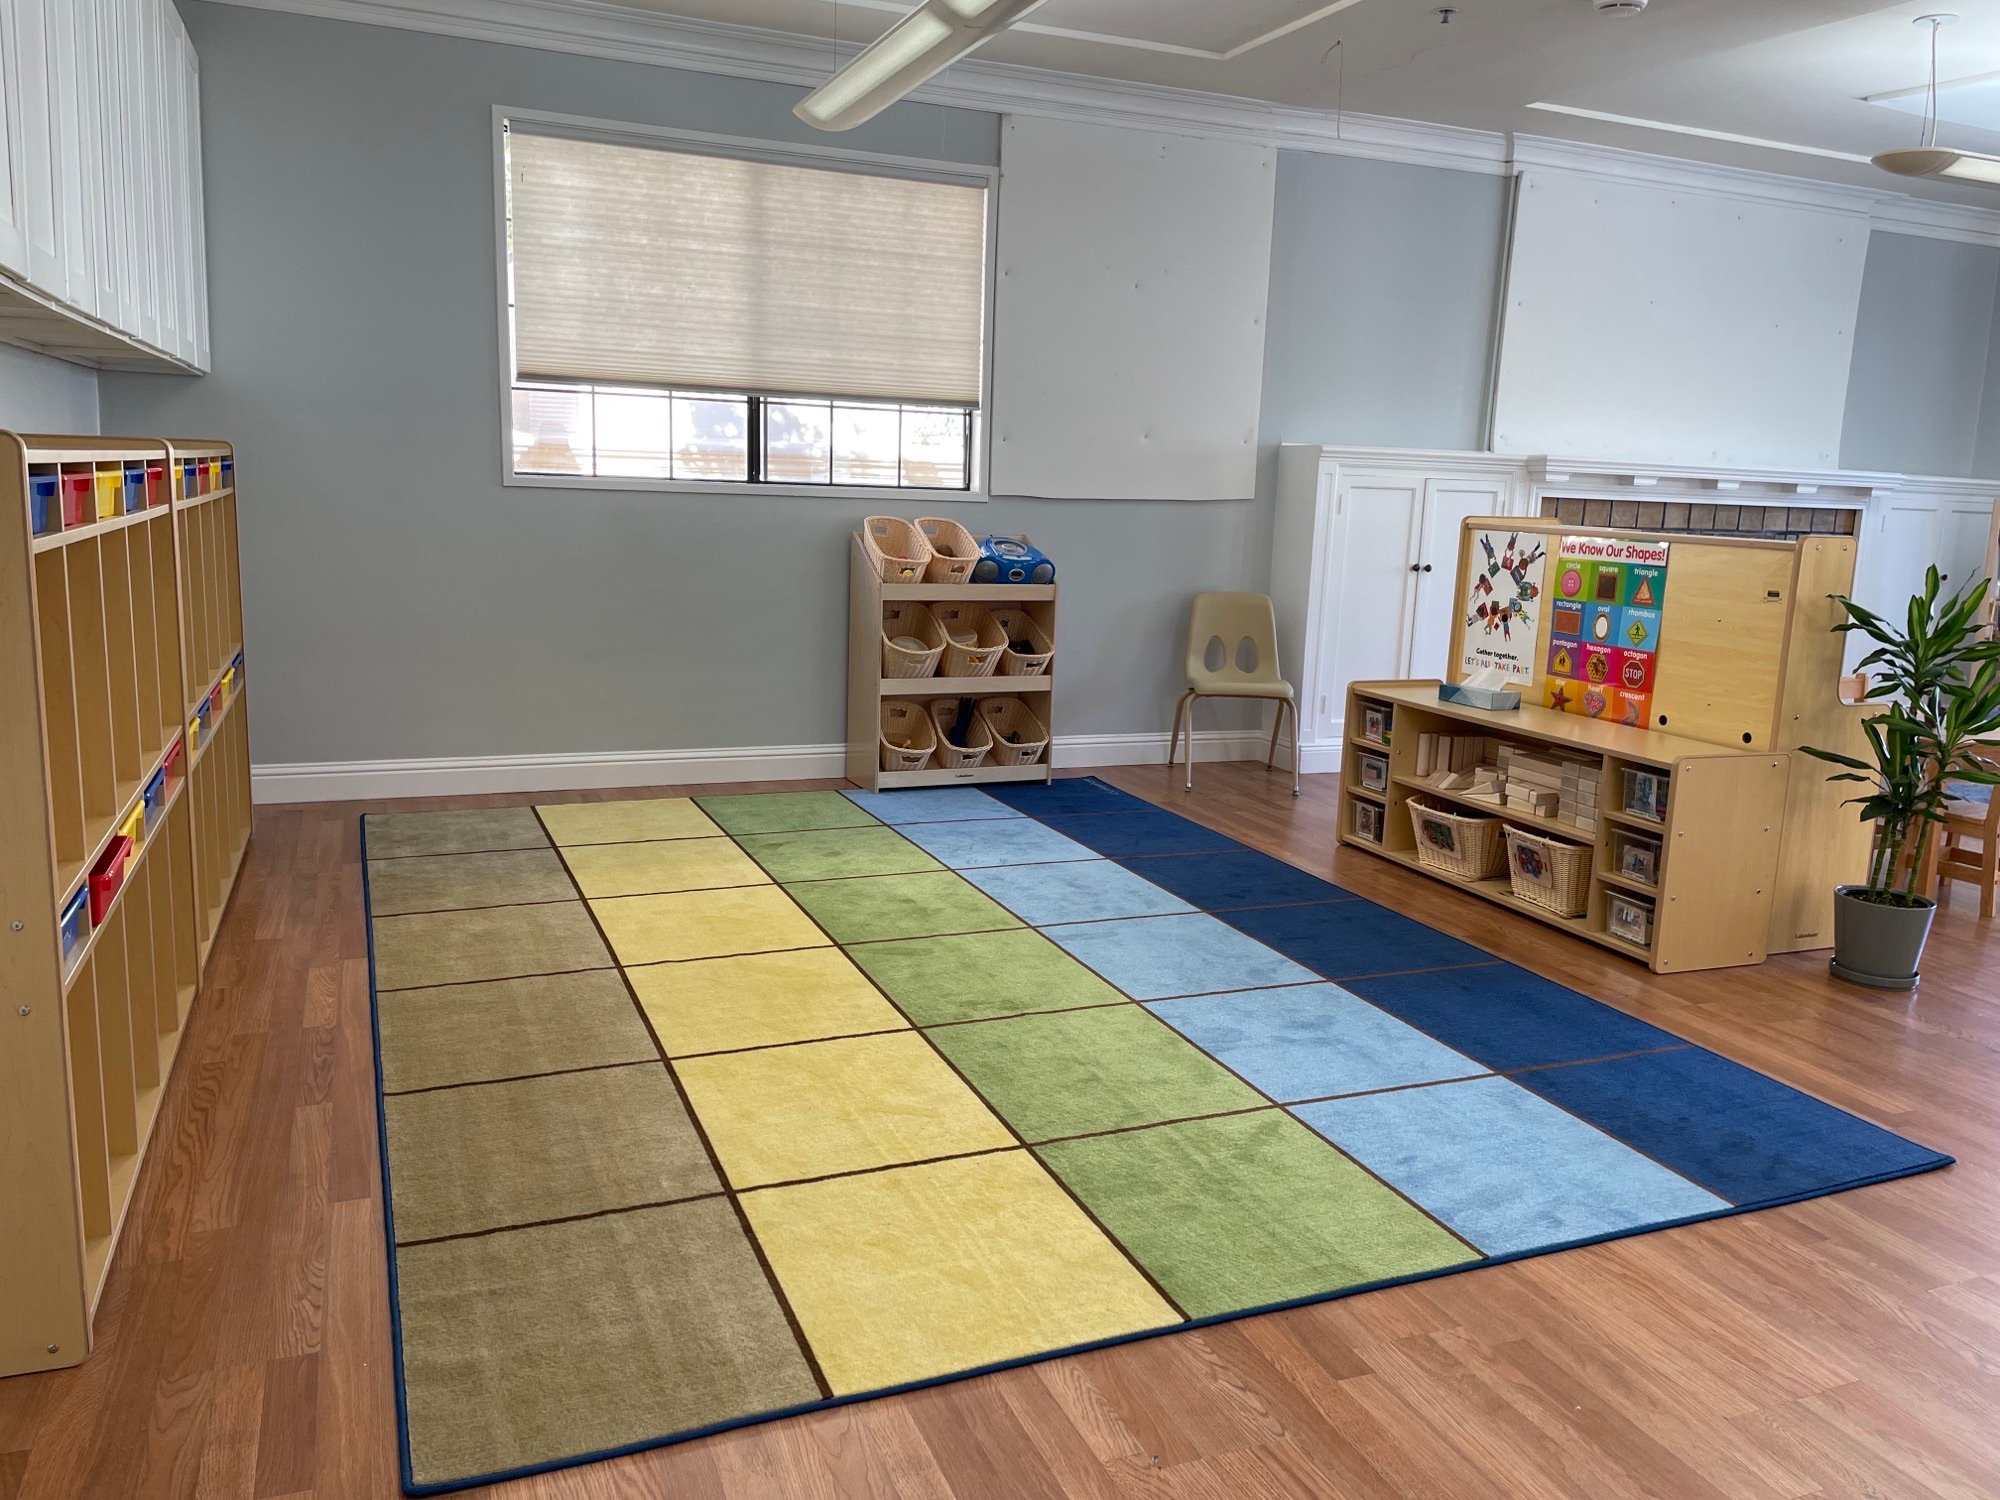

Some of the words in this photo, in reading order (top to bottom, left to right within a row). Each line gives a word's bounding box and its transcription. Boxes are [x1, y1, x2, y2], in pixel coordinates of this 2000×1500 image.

[1562, 541, 1576, 554] We
[1579, 543, 1604, 556] Know
[1606, 544, 1624, 558] Our
[1625, 546, 1665, 563] Shapes!
[1565, 562, 1581, 570] circle
[1599, 565, 1619, 573] square
[1634, 567, 1659, 577] triangle
[1556, 600, 1581, 610] rectangle
[1597, 605, 1610, 613] oval
[1627, 609, 1656, 619] rhombus
[1552, 638, 1578, 649] pentagon
[1586, 643, 1612, 655] hexagon
[1623, 650, 1648, 660] octagon
[1465, 657, 1479, 666] LET'S
[1495, 662, 1510, 672] TAKE
[1625, 667, 1643, 679] STOP
[1588, 684, 1604, 693] heart
[1619, 691, 1645, 701] crescent
